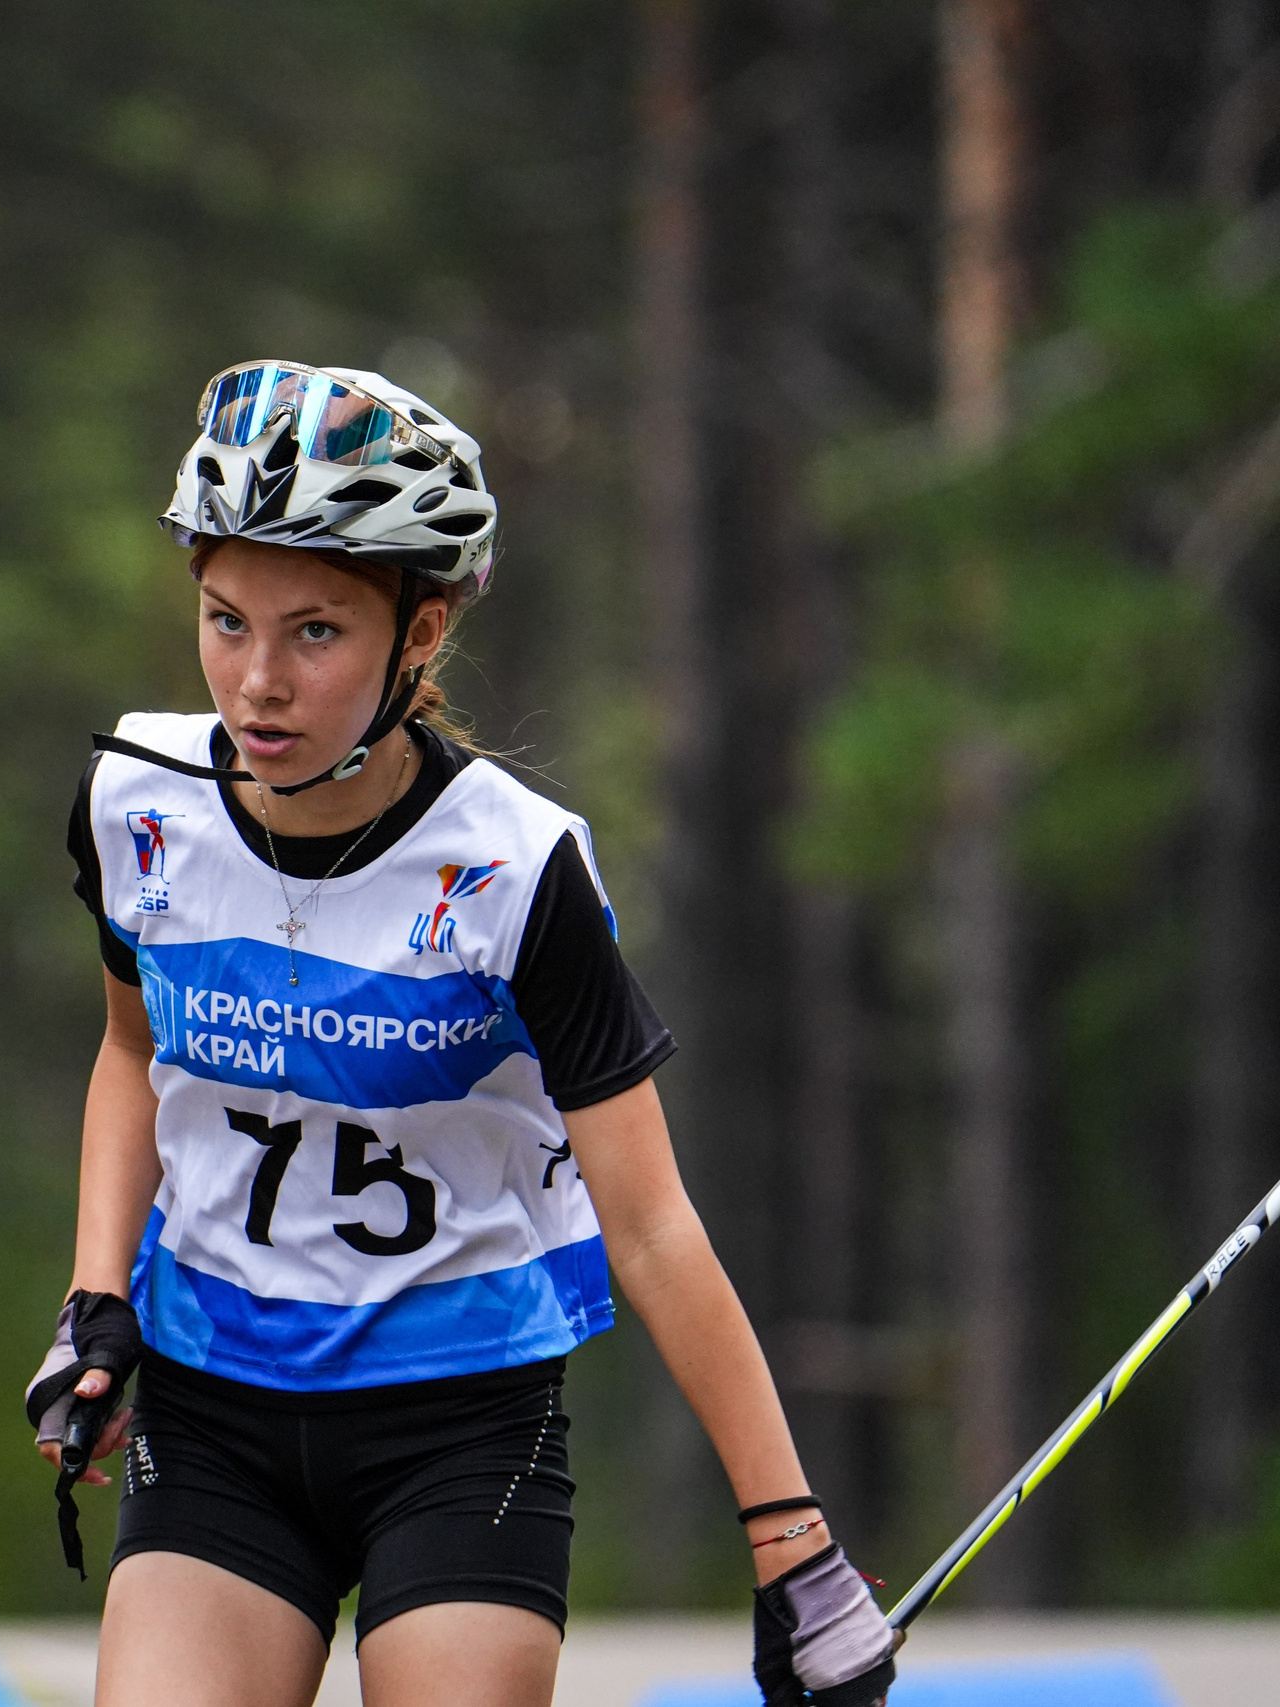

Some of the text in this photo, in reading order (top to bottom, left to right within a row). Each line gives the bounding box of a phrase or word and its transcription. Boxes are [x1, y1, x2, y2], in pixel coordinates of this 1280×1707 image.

[185, 1029, 286, 1078] КРАЙ
[223, 1106, 437, 1257] 75
[538, 1138, 584, 1190] 7
[1206, 1231, 1247, 1280] RACE
[134, 1434, 155, 1471] RAFT
